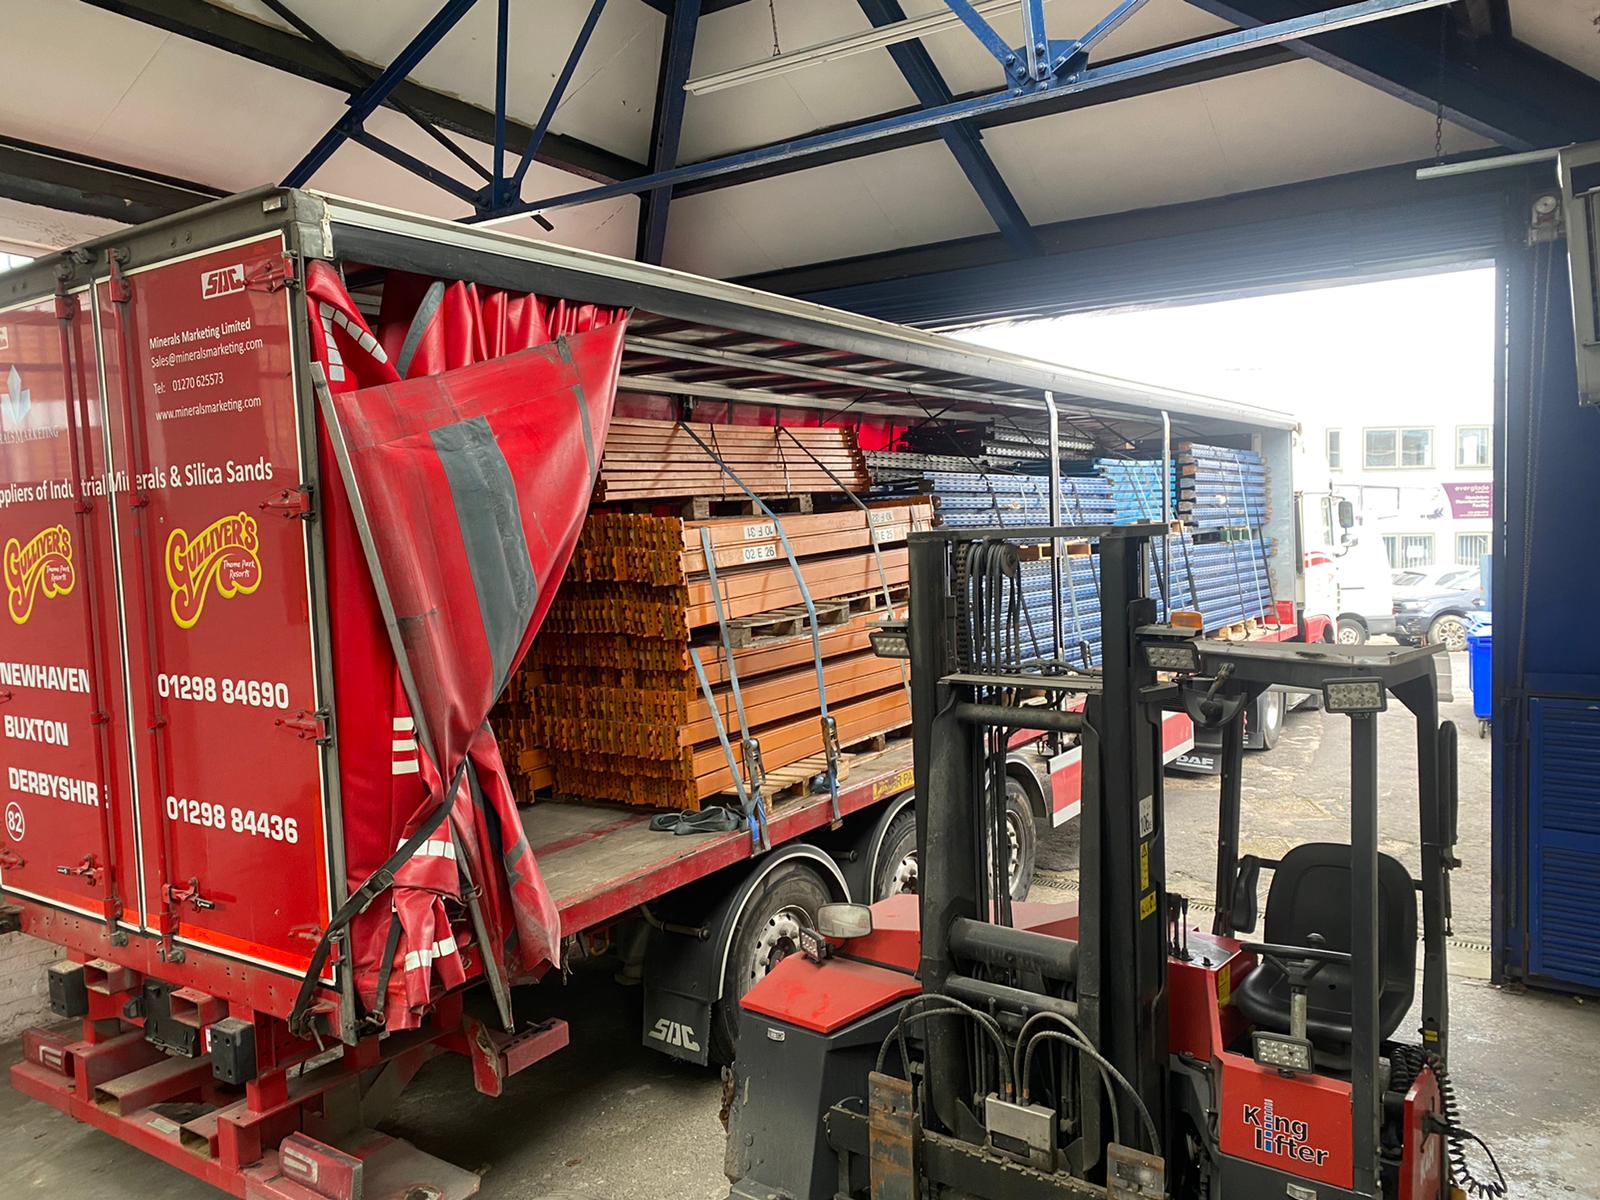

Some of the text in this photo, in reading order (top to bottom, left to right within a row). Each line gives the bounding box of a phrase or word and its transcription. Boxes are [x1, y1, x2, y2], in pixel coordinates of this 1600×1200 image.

[149, 317, 251, 350] Minerals Marketing Limited
[151, 338, 263, 368] Sales@mineralsmarketing.com
[172, 376, 195, 392] 01270
[196, 372, 224, 387] 625573
[155, 396, 262, 421] www.mineralsmarketing.com
[36, 480, 47, 500] of
[170, 465, 182, 488] &
[185, 462, 223, 486] Silica
[226, 456, 273, 483] Sands
[745, 549, 755, 560] 02
[764, 546, 775, 557] 26
[0, 662, 90, 694] NEWHAVEN
[157, 673, 289, 709] 01298 84690
[4, 715, 69, 746] BUXTON
[1177, 755, 1214, 765] DAF
[7, 810, 23, 833] 82
[166, 796, 298, 844] 01298 84436
[647, 1018, 700, 1052] SDC
[1243, 1098, 1309, 1141] King
[1254, 1127, 1329, 1167] lifter
